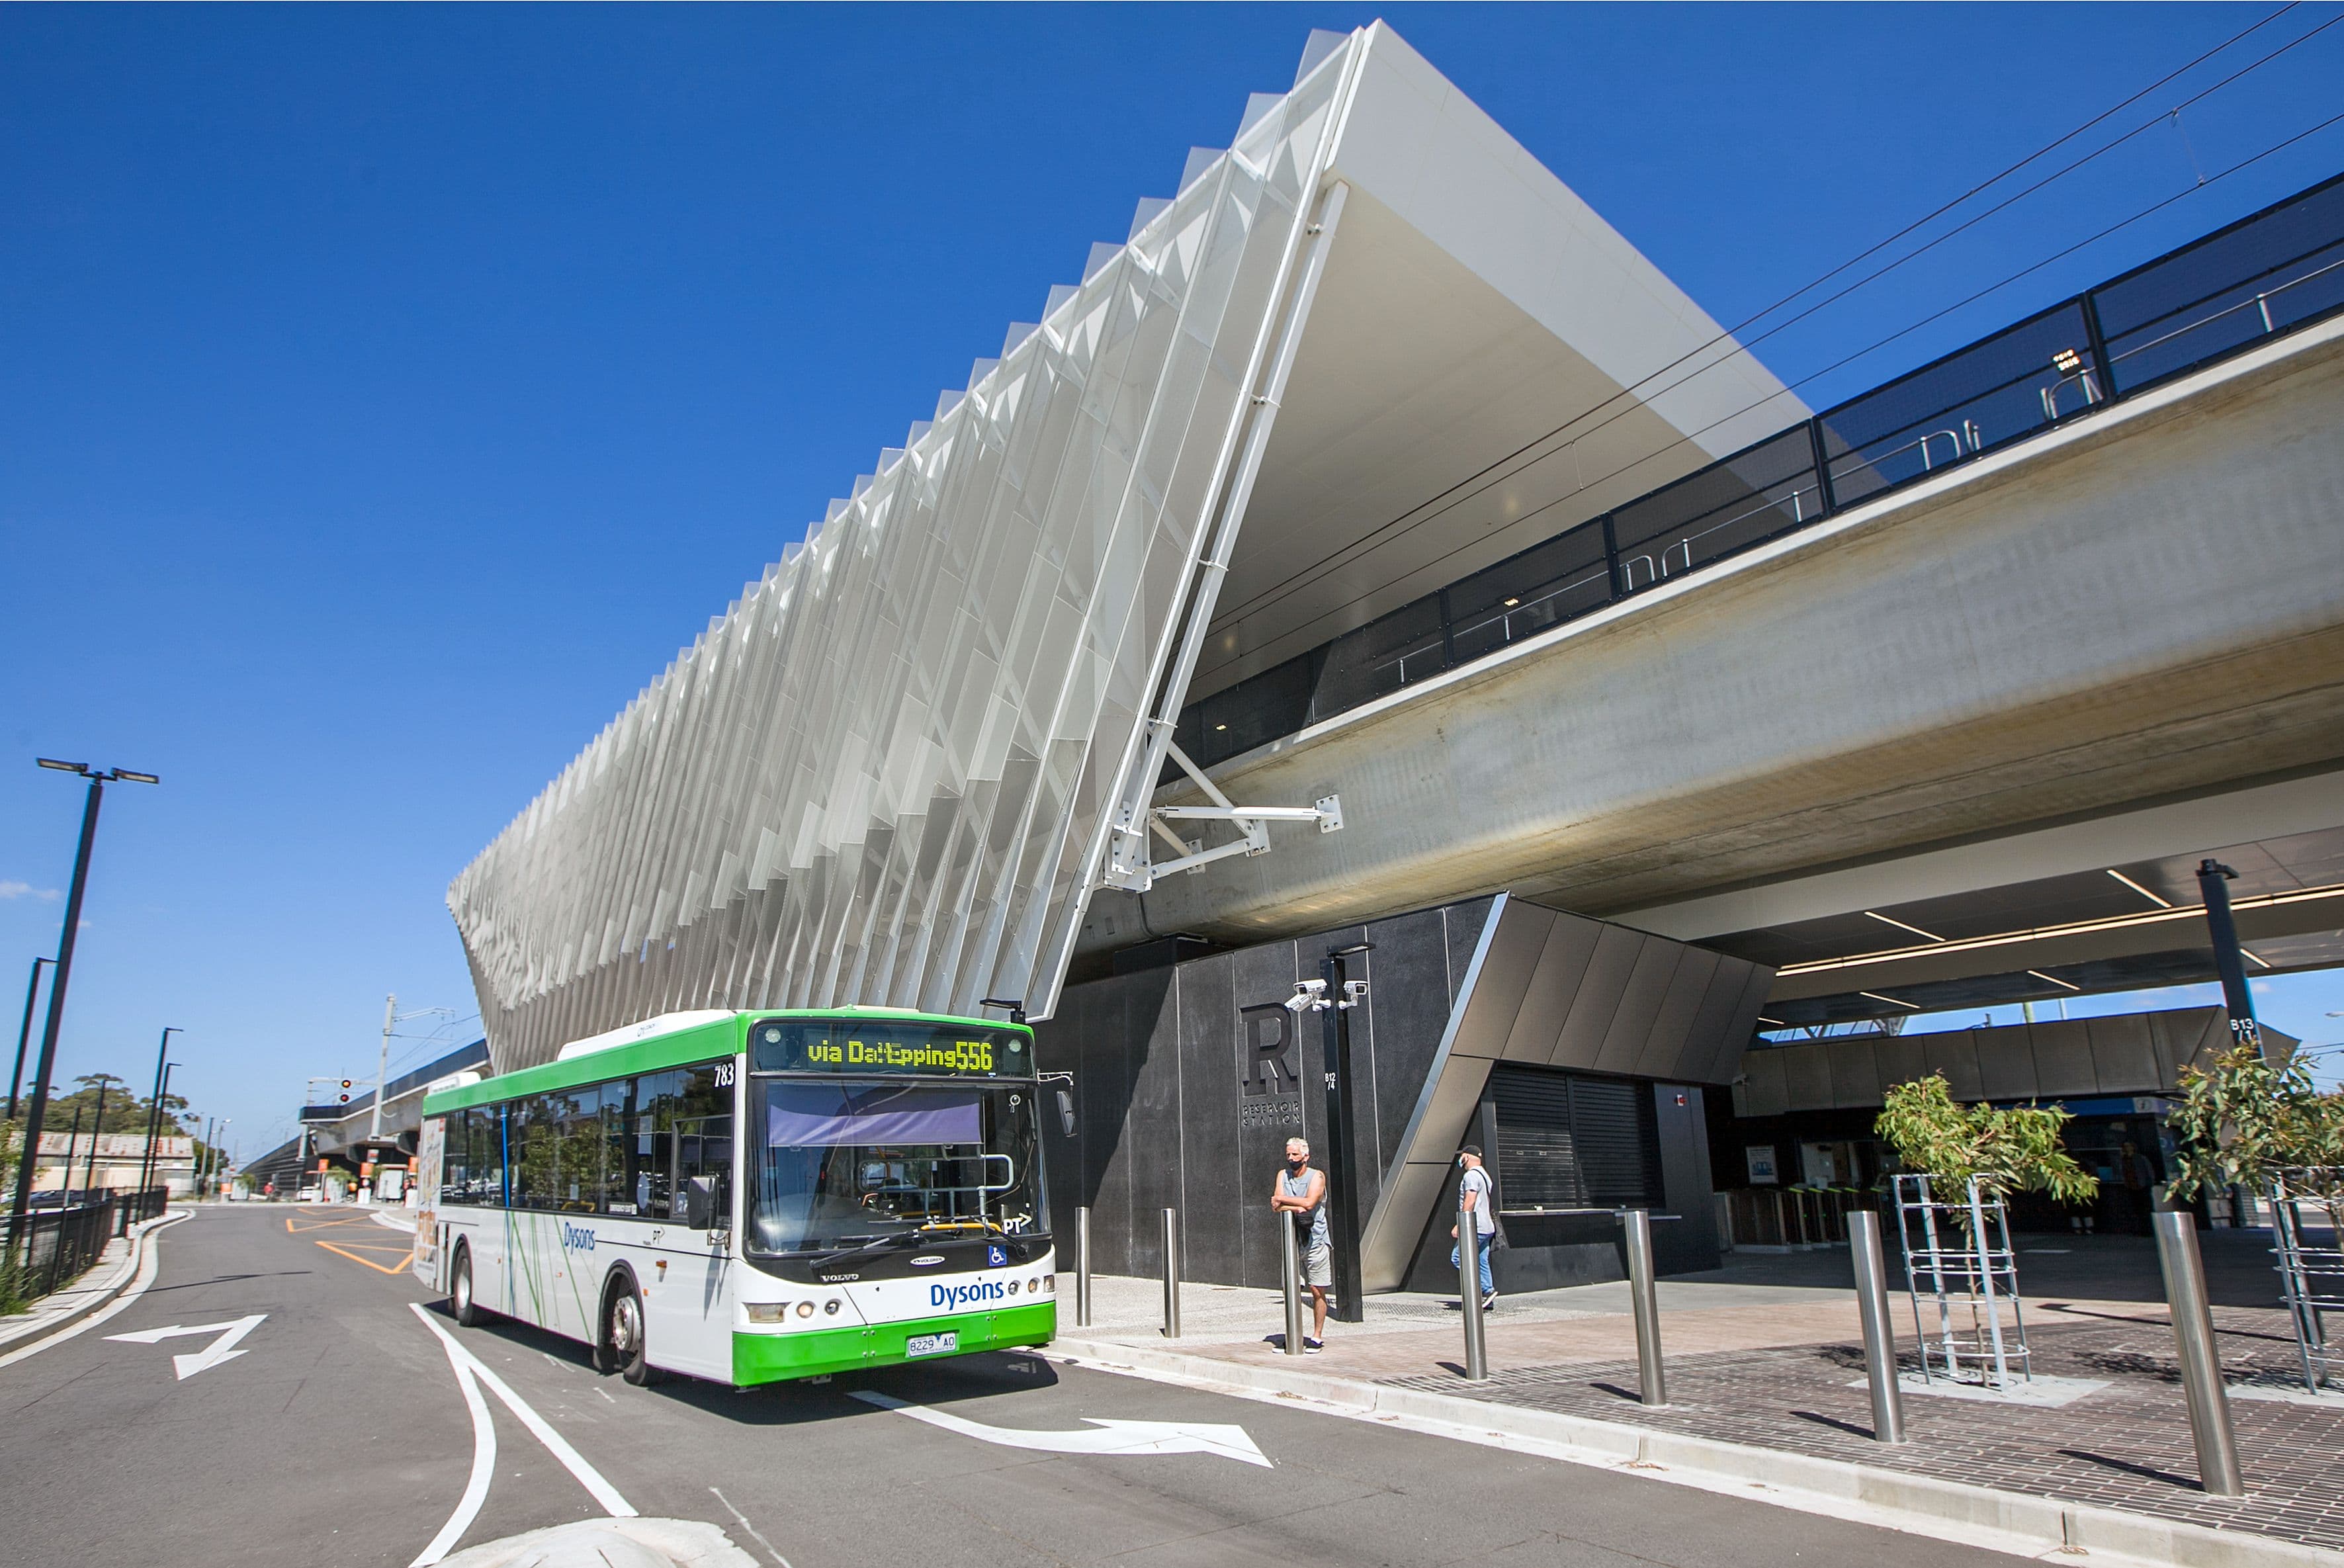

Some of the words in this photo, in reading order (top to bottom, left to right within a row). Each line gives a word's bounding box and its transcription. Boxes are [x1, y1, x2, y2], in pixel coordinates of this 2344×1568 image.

[2230, 1018, 2254, 1030] B13
[808, 1039, 842, 1062] via
[1240, 1002, 1298, 1098] R
[715, 1063, 734, 1087] 783
[1325, 1072, 1336, 1082] B12
[1243, 1101, 1299, 1115] RESERVOIR
[1243, 1113, 1300, 1126] STATION
[564, 1222, 595, 1255] Dysons
[931, 1282, 1004, 1311] Dysons
[910, 1340, 934, 1352] 8229
